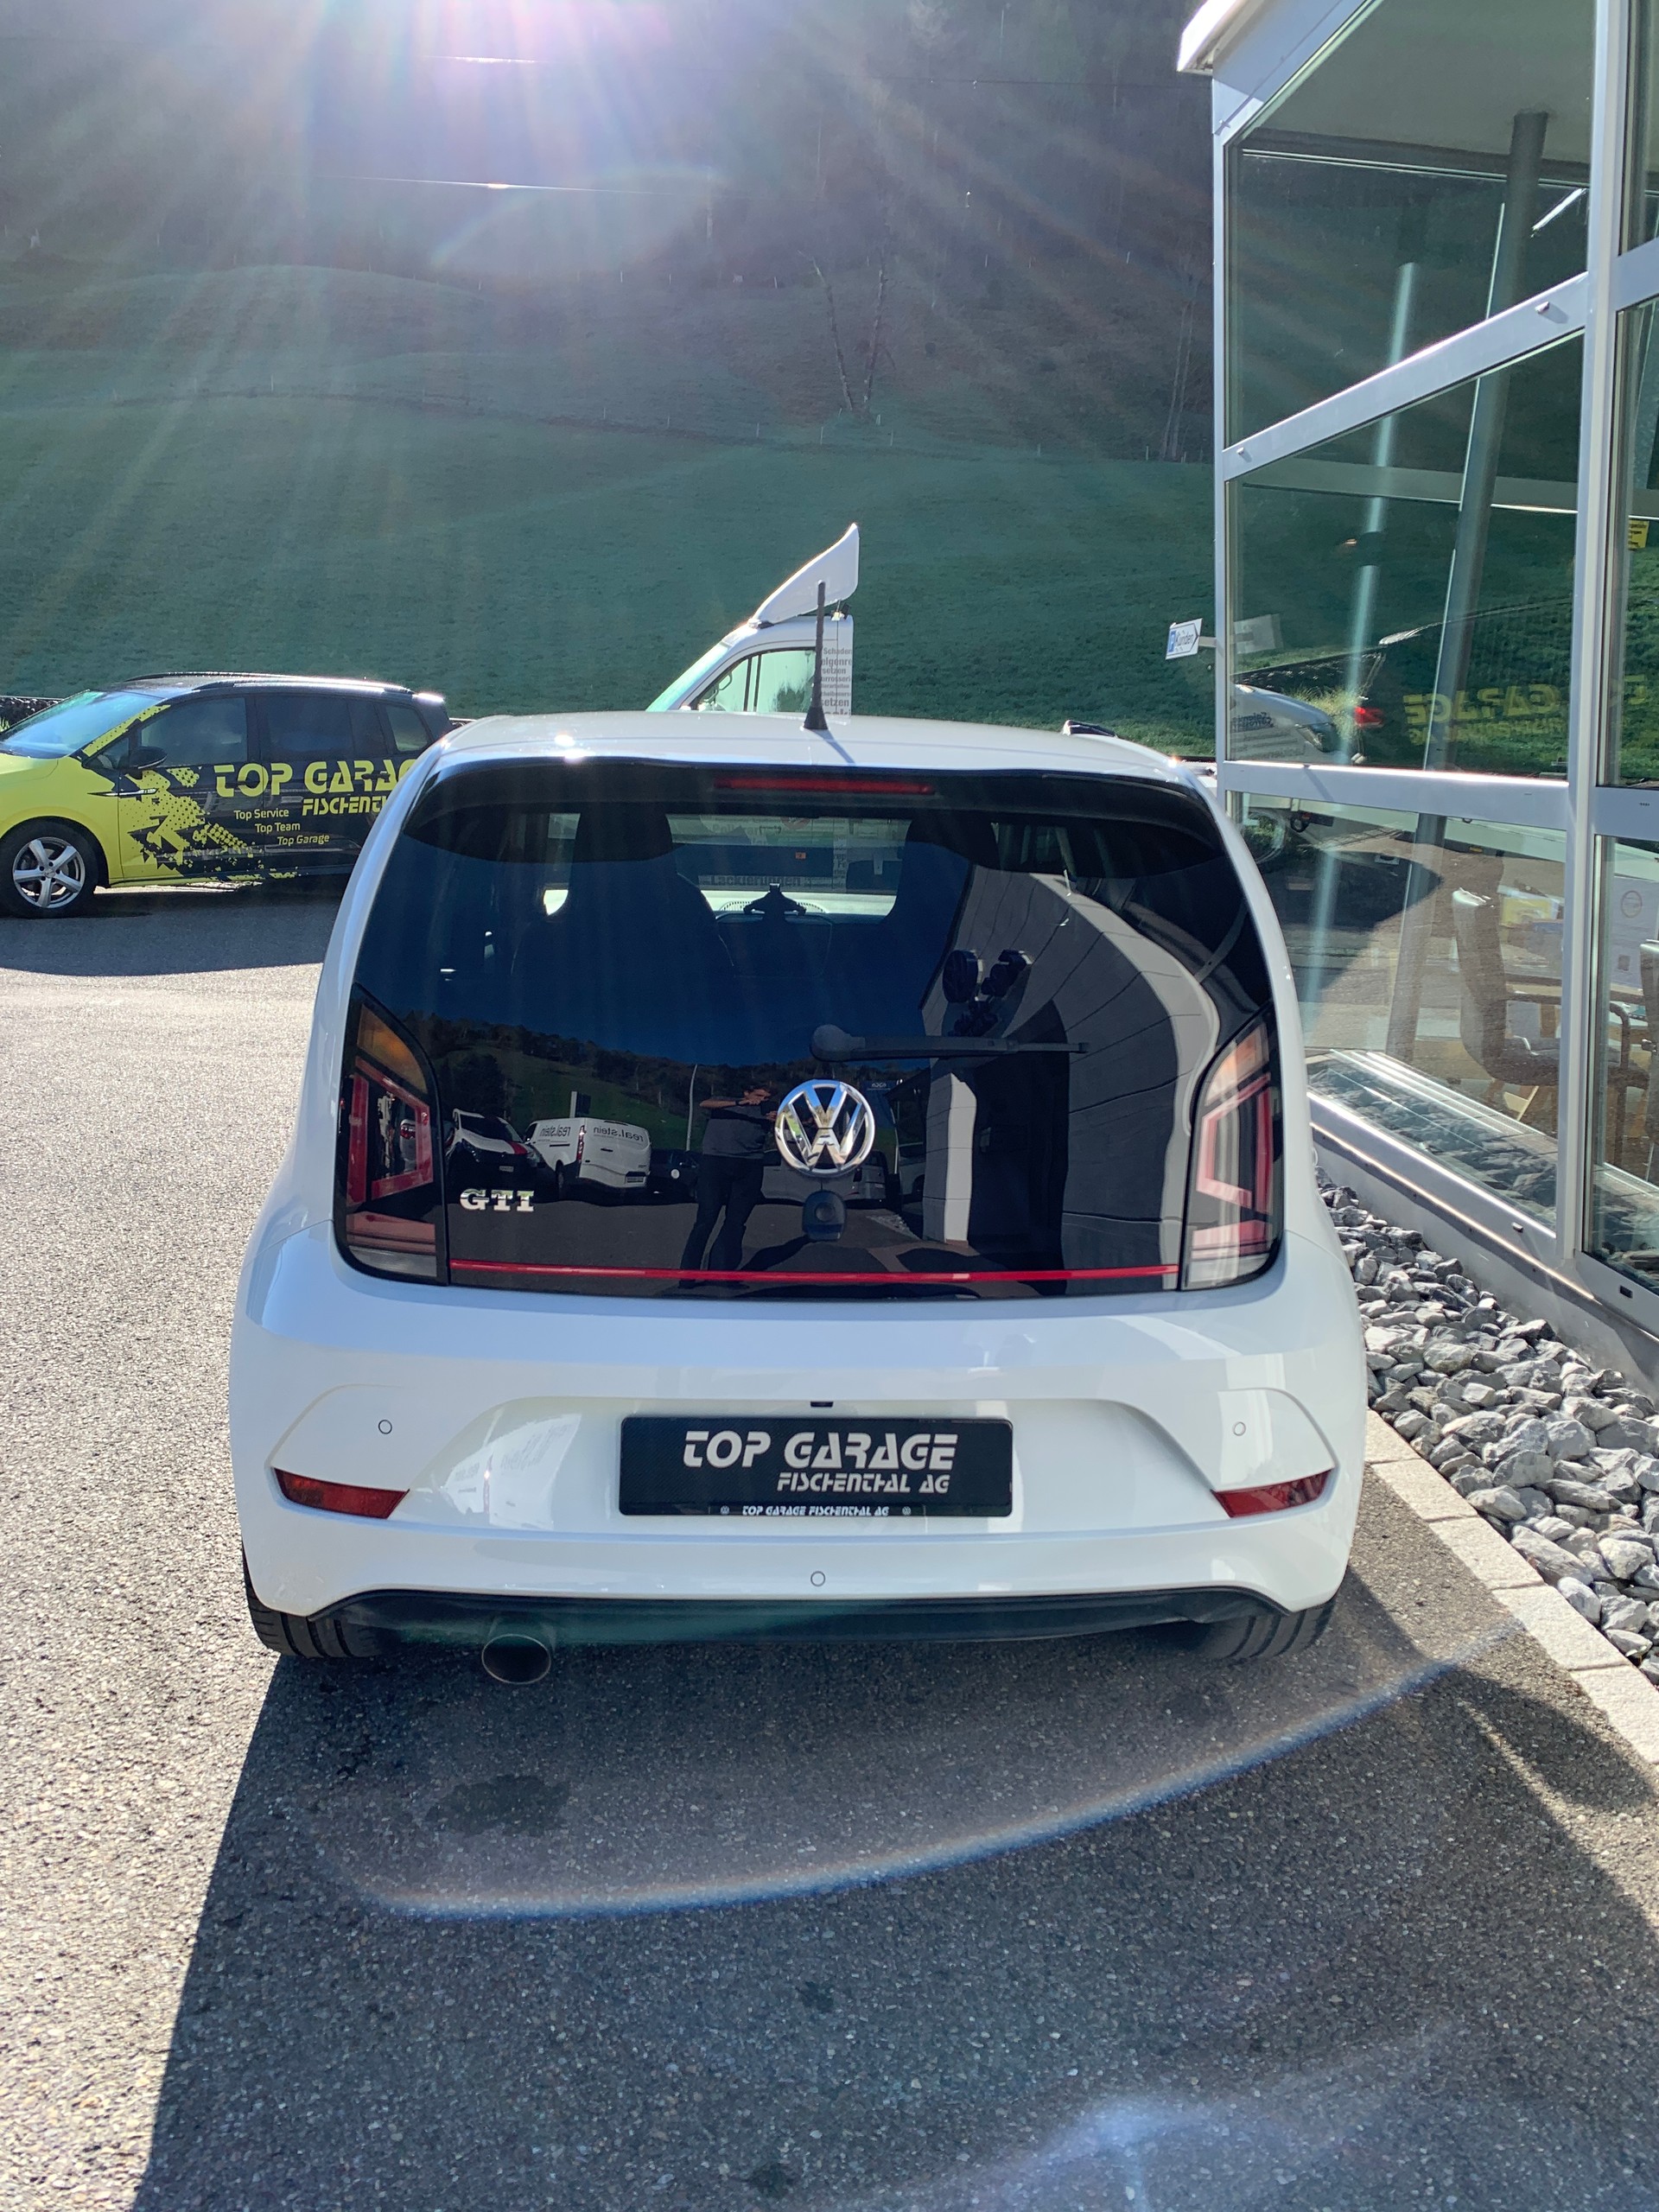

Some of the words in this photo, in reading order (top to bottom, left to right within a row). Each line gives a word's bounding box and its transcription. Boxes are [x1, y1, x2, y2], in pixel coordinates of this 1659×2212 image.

[214, 763, 293, 797] TOP
[234, 810, 252, 821] Top
[254, 808, 289, 818] Service
[255, 823, 272, 833] Top
[275, 821, 301, 831] Team
[277, 836, 294, 846] Top
[296, 834, 330, 845] Garage
[460, 1188, 535, 1212] GTI
[683, 1430, 771, 1468] TOP
[784, 1432, 958, 1471] GARAGE
[778, 1472, 911, 1493] FISCHENTHAL
[918, 1474, 950, 1493] AG
[742, 1505, 763, 1516] TOP
[766, 1506, 806, 1516] GARAGE
[809, 1506, 872, 1516] FISCHENTHAL
[874, 1506, 890, 1516] AG
